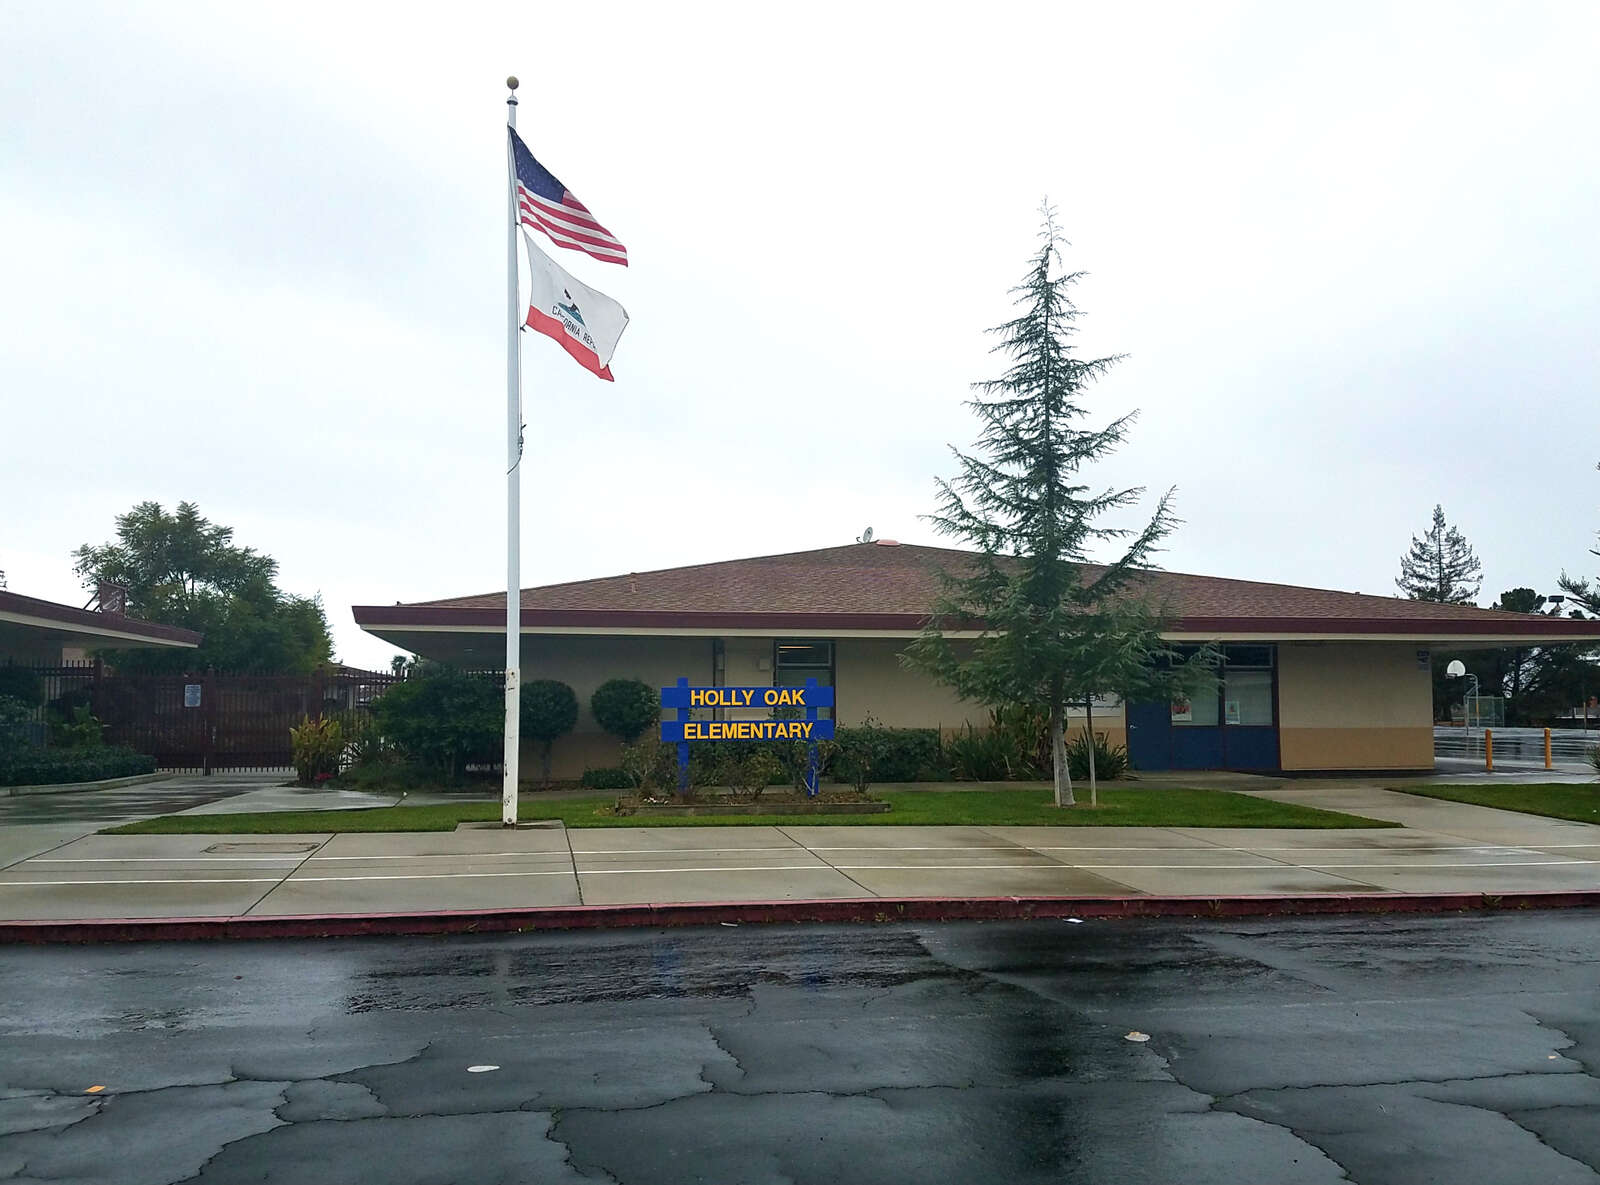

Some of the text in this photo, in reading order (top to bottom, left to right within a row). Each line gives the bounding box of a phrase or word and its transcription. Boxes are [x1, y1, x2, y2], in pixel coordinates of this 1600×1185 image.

[690, 689, 806, 706] HOLLY OAK
[683, 722, 814, 740] ELEMENTARY
